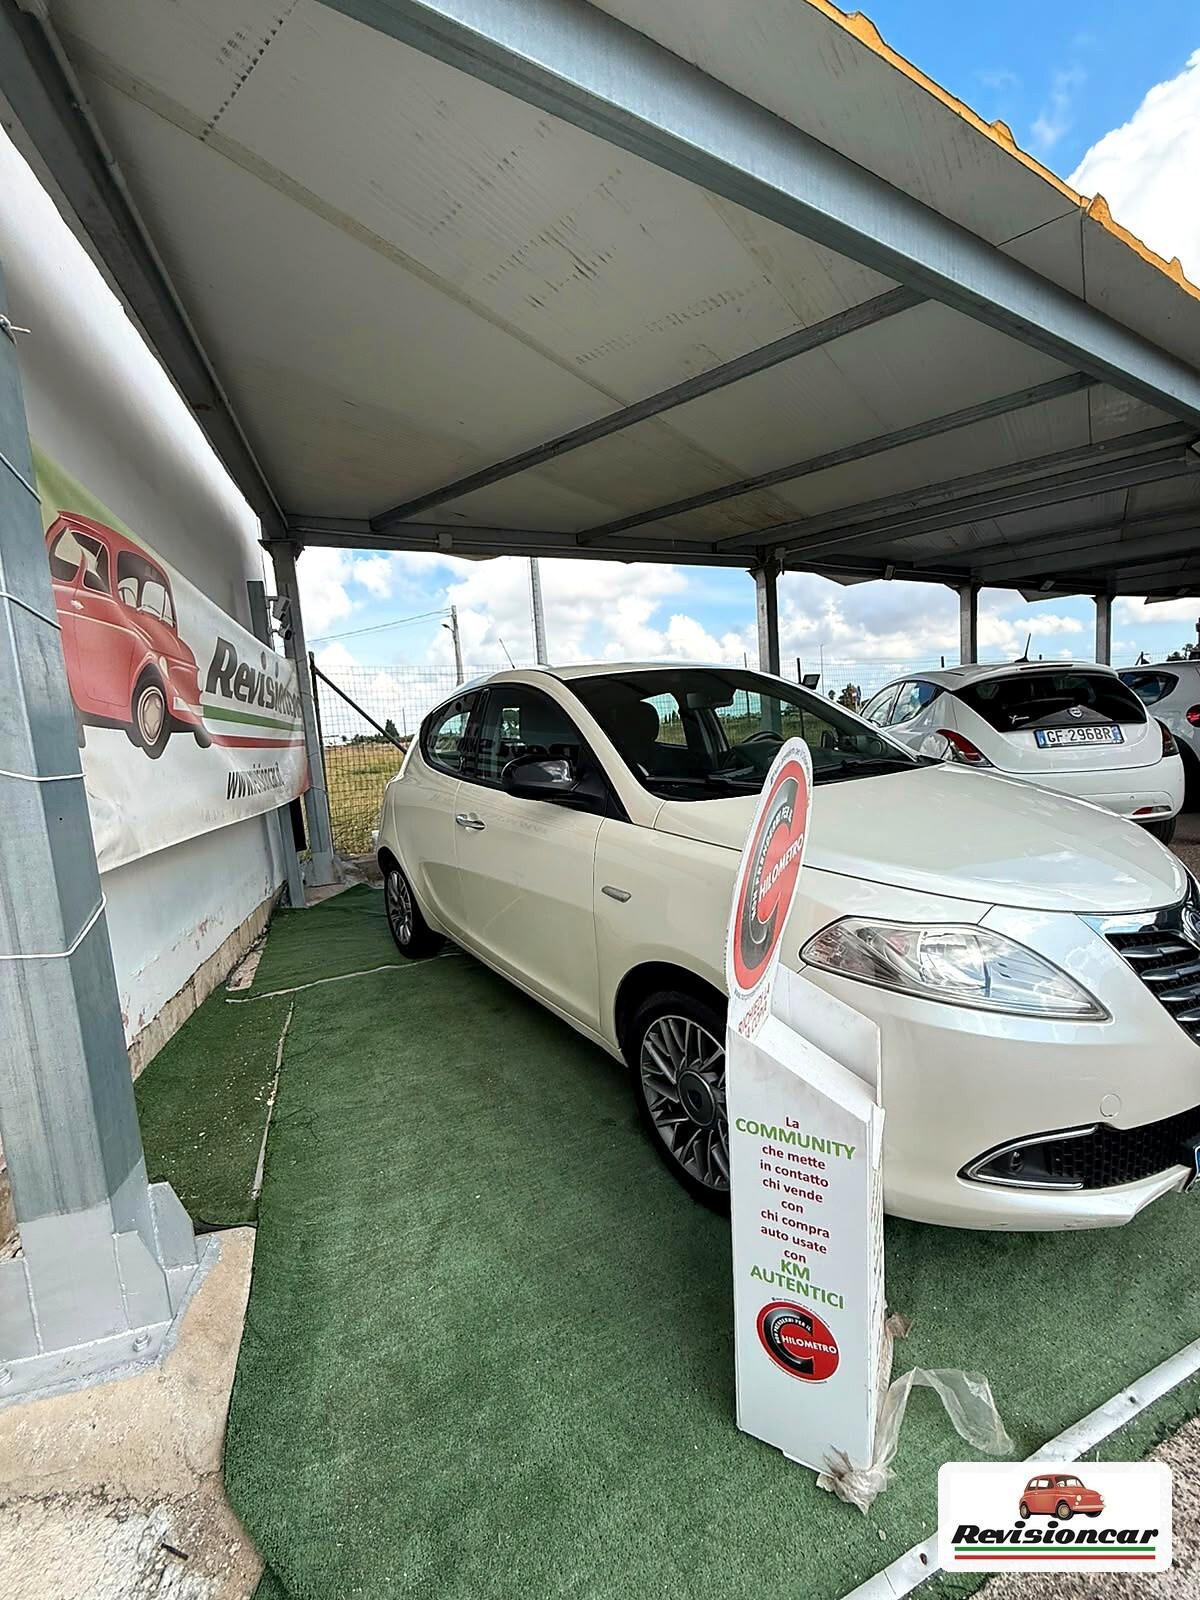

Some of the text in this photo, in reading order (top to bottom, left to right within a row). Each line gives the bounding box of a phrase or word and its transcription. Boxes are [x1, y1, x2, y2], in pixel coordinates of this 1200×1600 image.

[785, 1116, 800, 1129] La
[735, 1118, 856, 1160] COMMUNITY
[762, 1145, 826, 1170] che mette
[760, 1159, 829, 1188] in contatto
[762, 1178, 823, 1203] chi vende
[781, 1200, 804, 1214] con
[760, 1209, 830, 1239] chi compra
[760, 1225, 827, 1254] auto usate
[783, 1249, 807, 1264] con
[780, 1259, 811, 1281] KM
[750, 1264, 844, 1309] AUTENTICI
